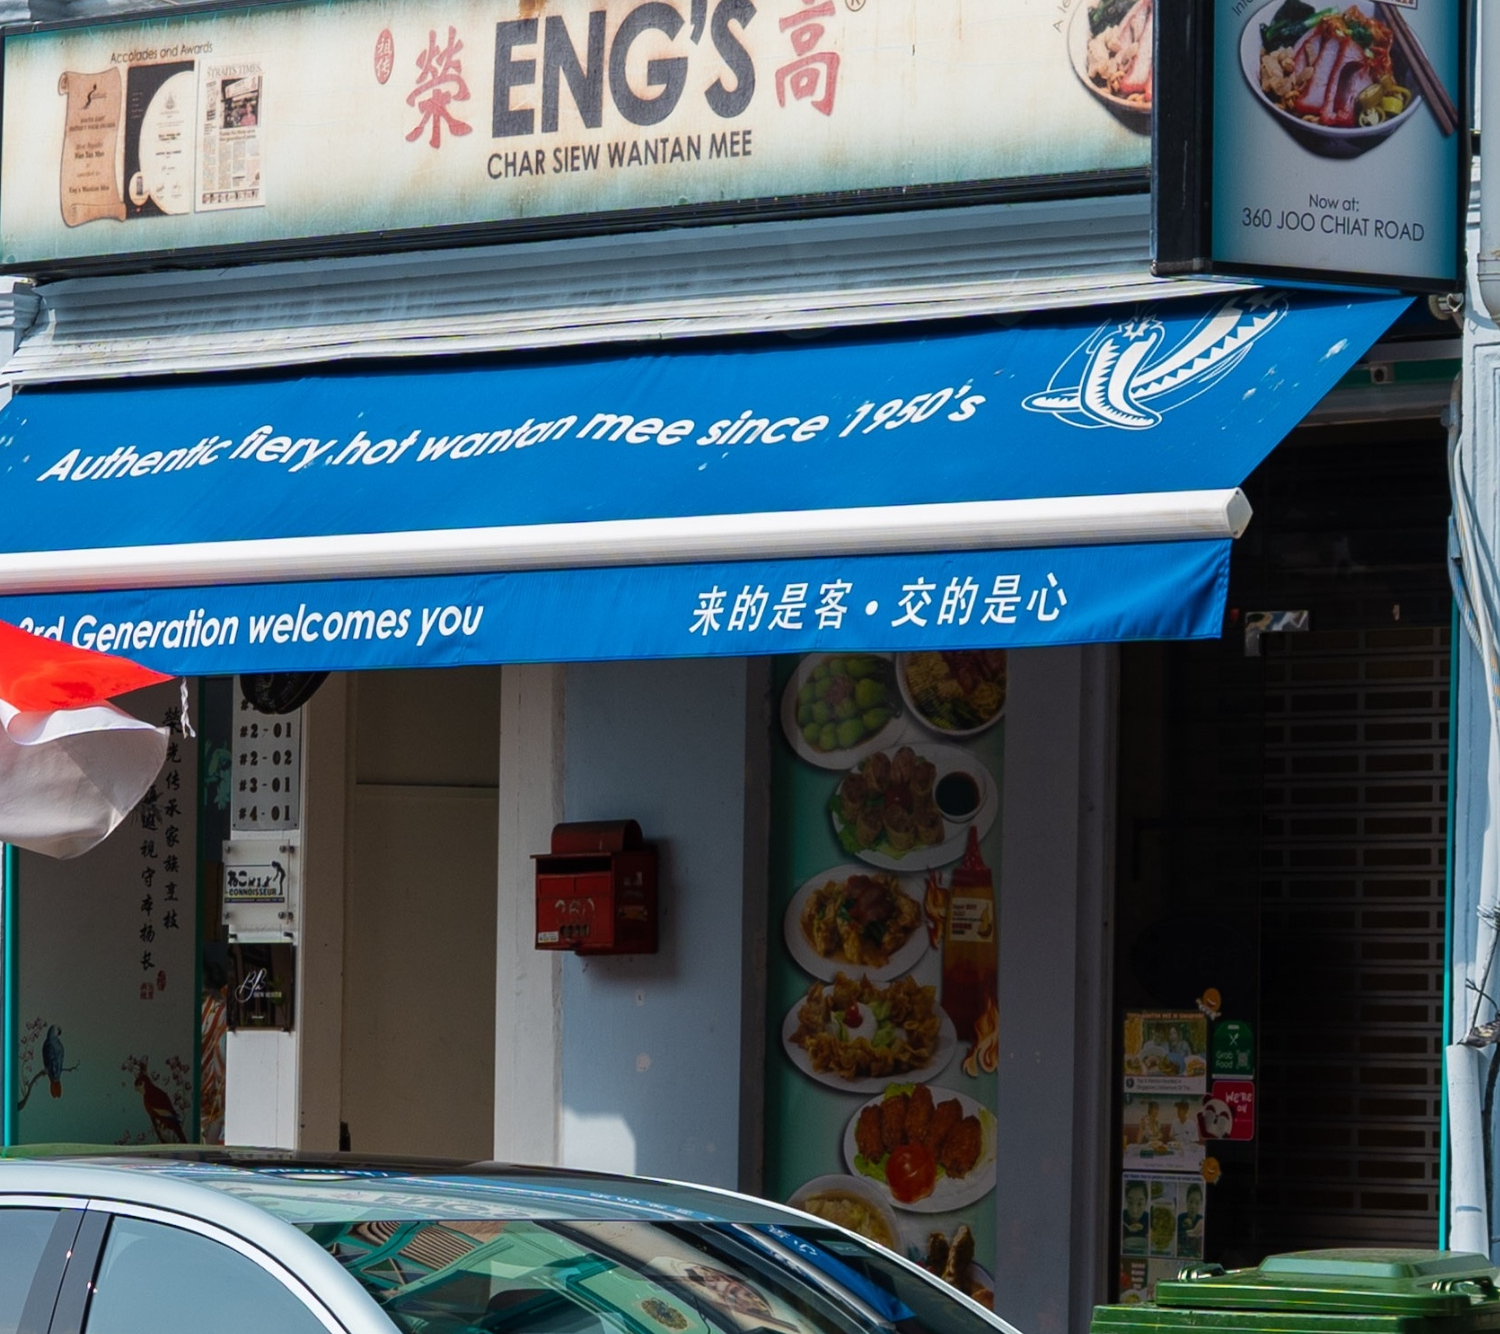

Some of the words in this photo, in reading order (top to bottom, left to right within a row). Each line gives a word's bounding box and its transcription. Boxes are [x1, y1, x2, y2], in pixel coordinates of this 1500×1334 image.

[110, 48, 158, 65] Accolades
[160, 46, 179, 58] and
[180, 42, 213, 55] Awards
[487, 150, 546, 180] CHAR
[552, 144, 600, 173] SIEW
[607, 135, 701, 169] WANTAN
[709, 129, 753, 158] MEE
[1309, 193, 1336, 210] Now
[1341, 196, 1359, 212] at:
[1241, 207, 1272, 230] 360
[1277, 211, 1315, 233] JOO
[1320, 215, 1369, 238] CHIAT
[1374, 219, 1425, 242] ROAD
[37, 431, 230, 482] Authentic
[332, 429, 419, 465] hot
[417, 413, 572, 463] wantan
[577, 411, 695, 446] mee
[697, 407, 831, 447] since
[838, 379, 987, 439] 1950's
[72, 607, 237, 653] Generation
[248, 603, 413, 645] welcomes
[417, 603, 483, 647] you
[239, 721, 292, 739] #2-01
[239, 749, 293, 767] #2-02
[239, 776, 292, 793] #3-01
[239, 805, 291, 822] #4-01
[229, 887, 277, 897] CONNOISSEUR
[1215, 1050, 1234, 1060] Grab
[1215, 1060, 1233, 1069] Food
